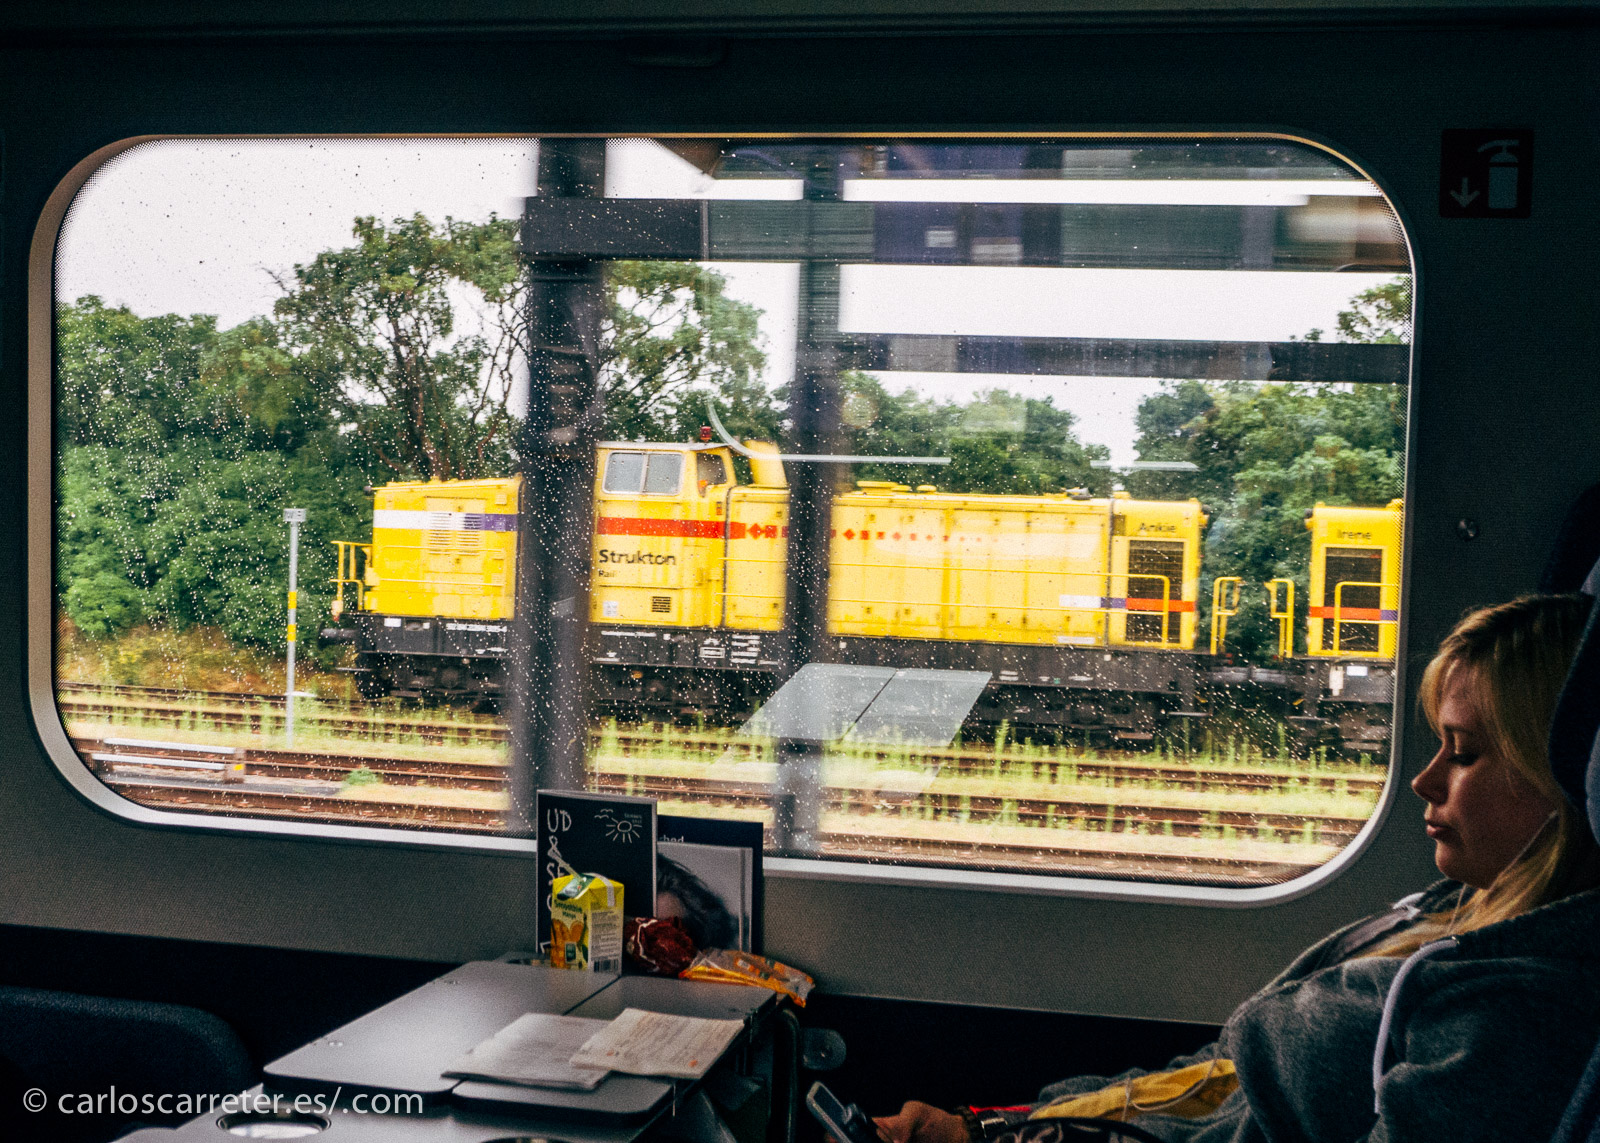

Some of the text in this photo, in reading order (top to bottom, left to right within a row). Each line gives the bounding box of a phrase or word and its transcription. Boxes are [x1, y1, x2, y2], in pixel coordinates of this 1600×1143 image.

[1336, 529, 1372, 540] Irene
[598, 549, 677, 566] Strukton
[598, 570, 616, 578] Rail
[547, 807, 572, 833] UD
